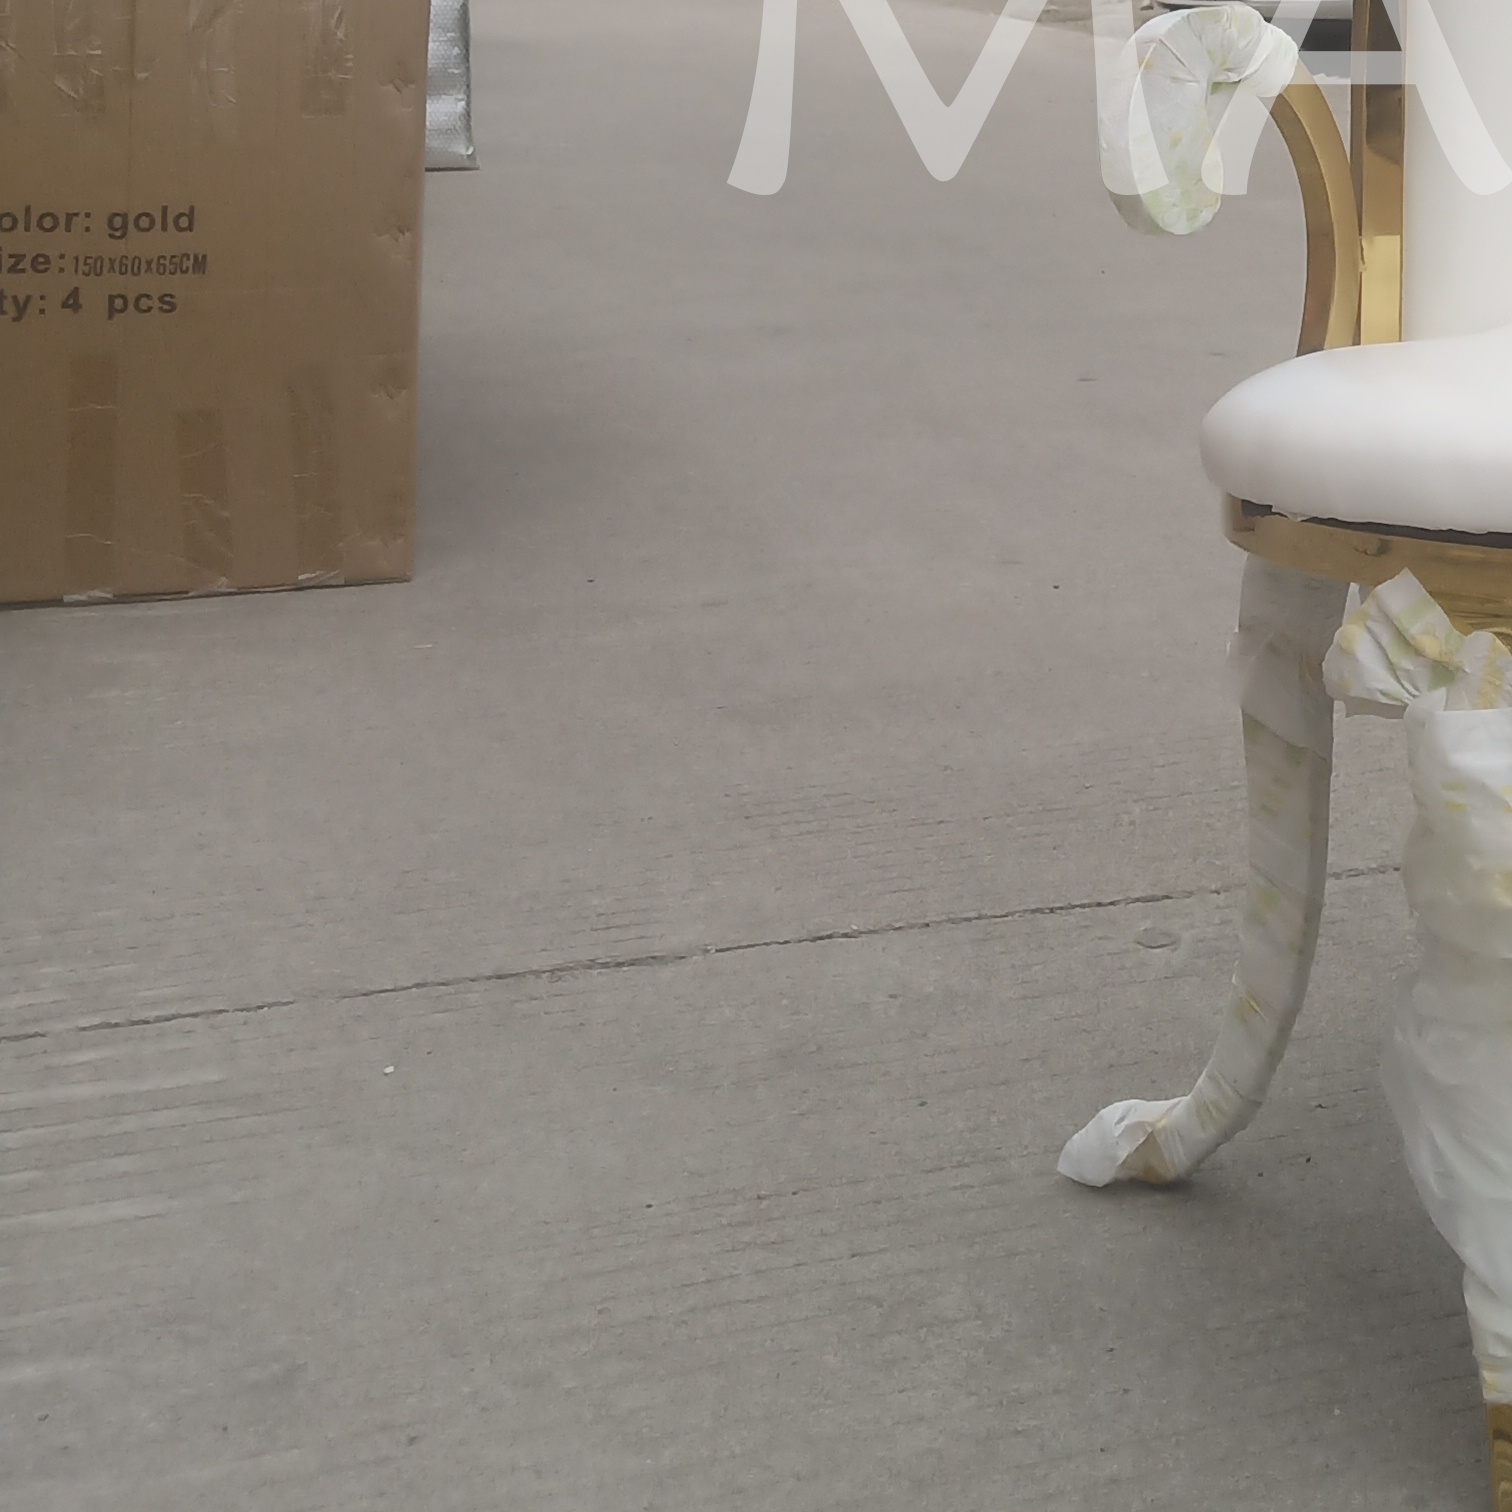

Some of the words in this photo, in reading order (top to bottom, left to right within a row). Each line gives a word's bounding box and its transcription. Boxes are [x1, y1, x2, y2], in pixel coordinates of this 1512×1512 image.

[107, 204, 195, 240] gold
[61, 286, 82, 314] 4
[107, 292, 177, 321] pcs
